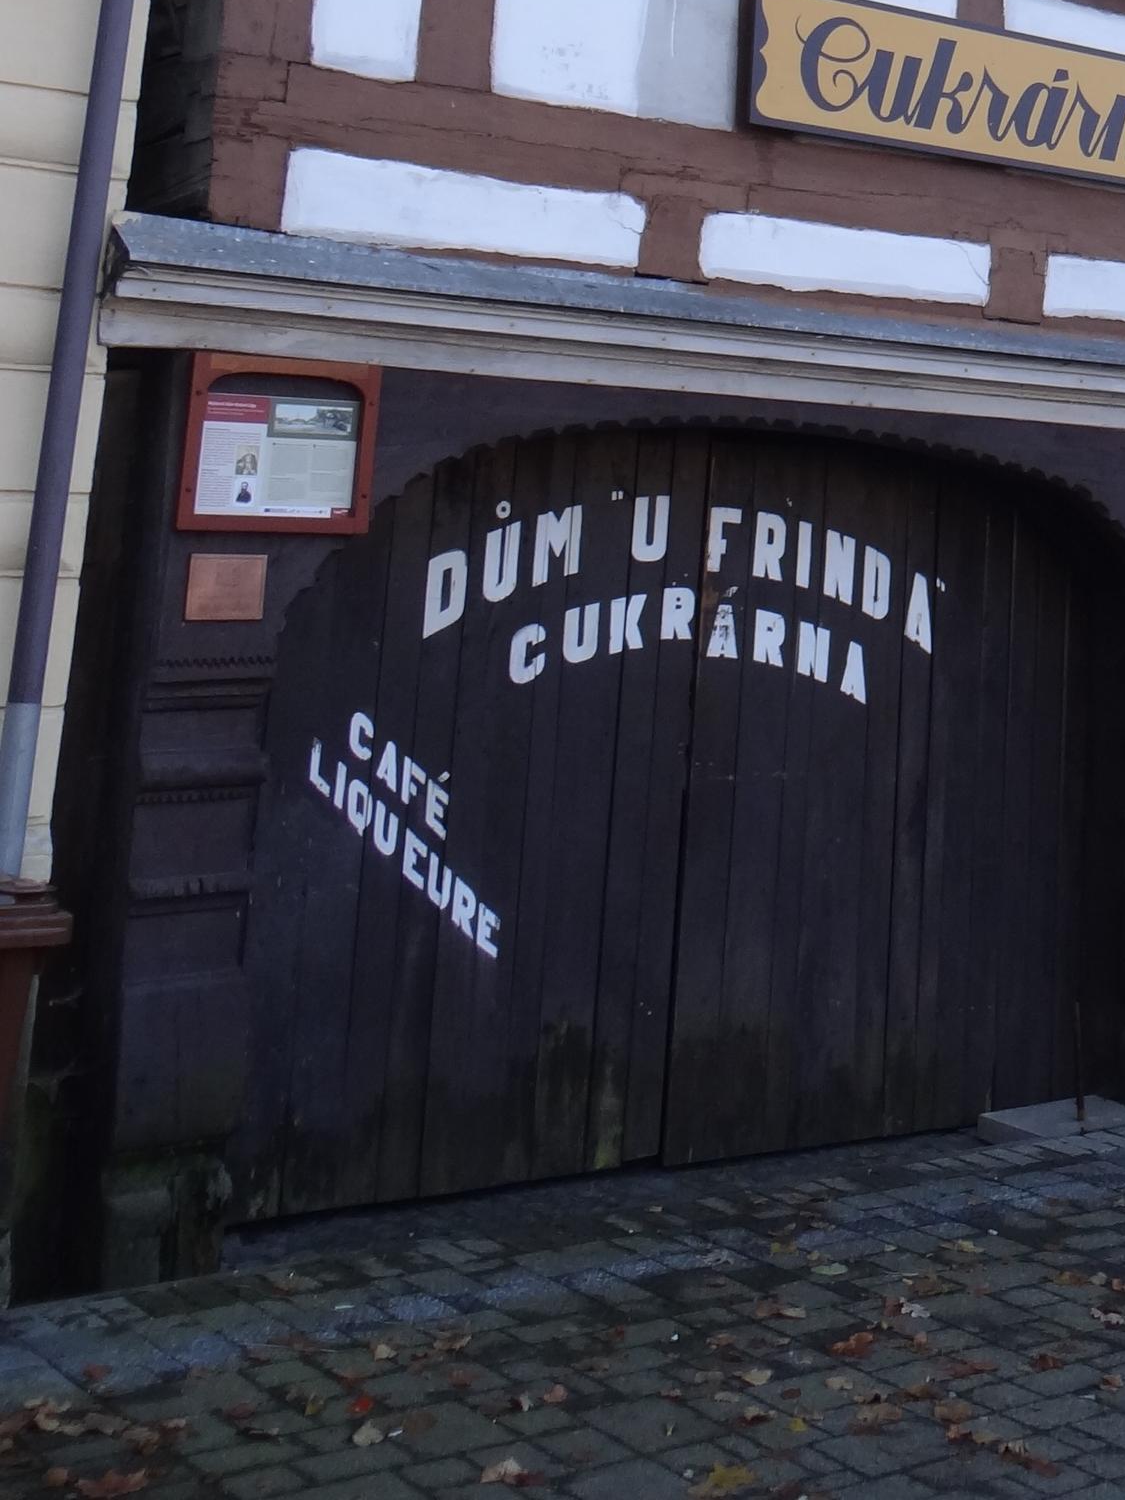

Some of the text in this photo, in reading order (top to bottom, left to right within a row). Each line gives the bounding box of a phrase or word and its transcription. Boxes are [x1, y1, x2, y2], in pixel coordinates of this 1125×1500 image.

[423, 501, 582, 638] DŮM
[509, 585, 866, 705] CUKRÁRNA
[350, 712, 451, 841] CAFÉ
[309, 736, 501, 958] LIQUEURE
